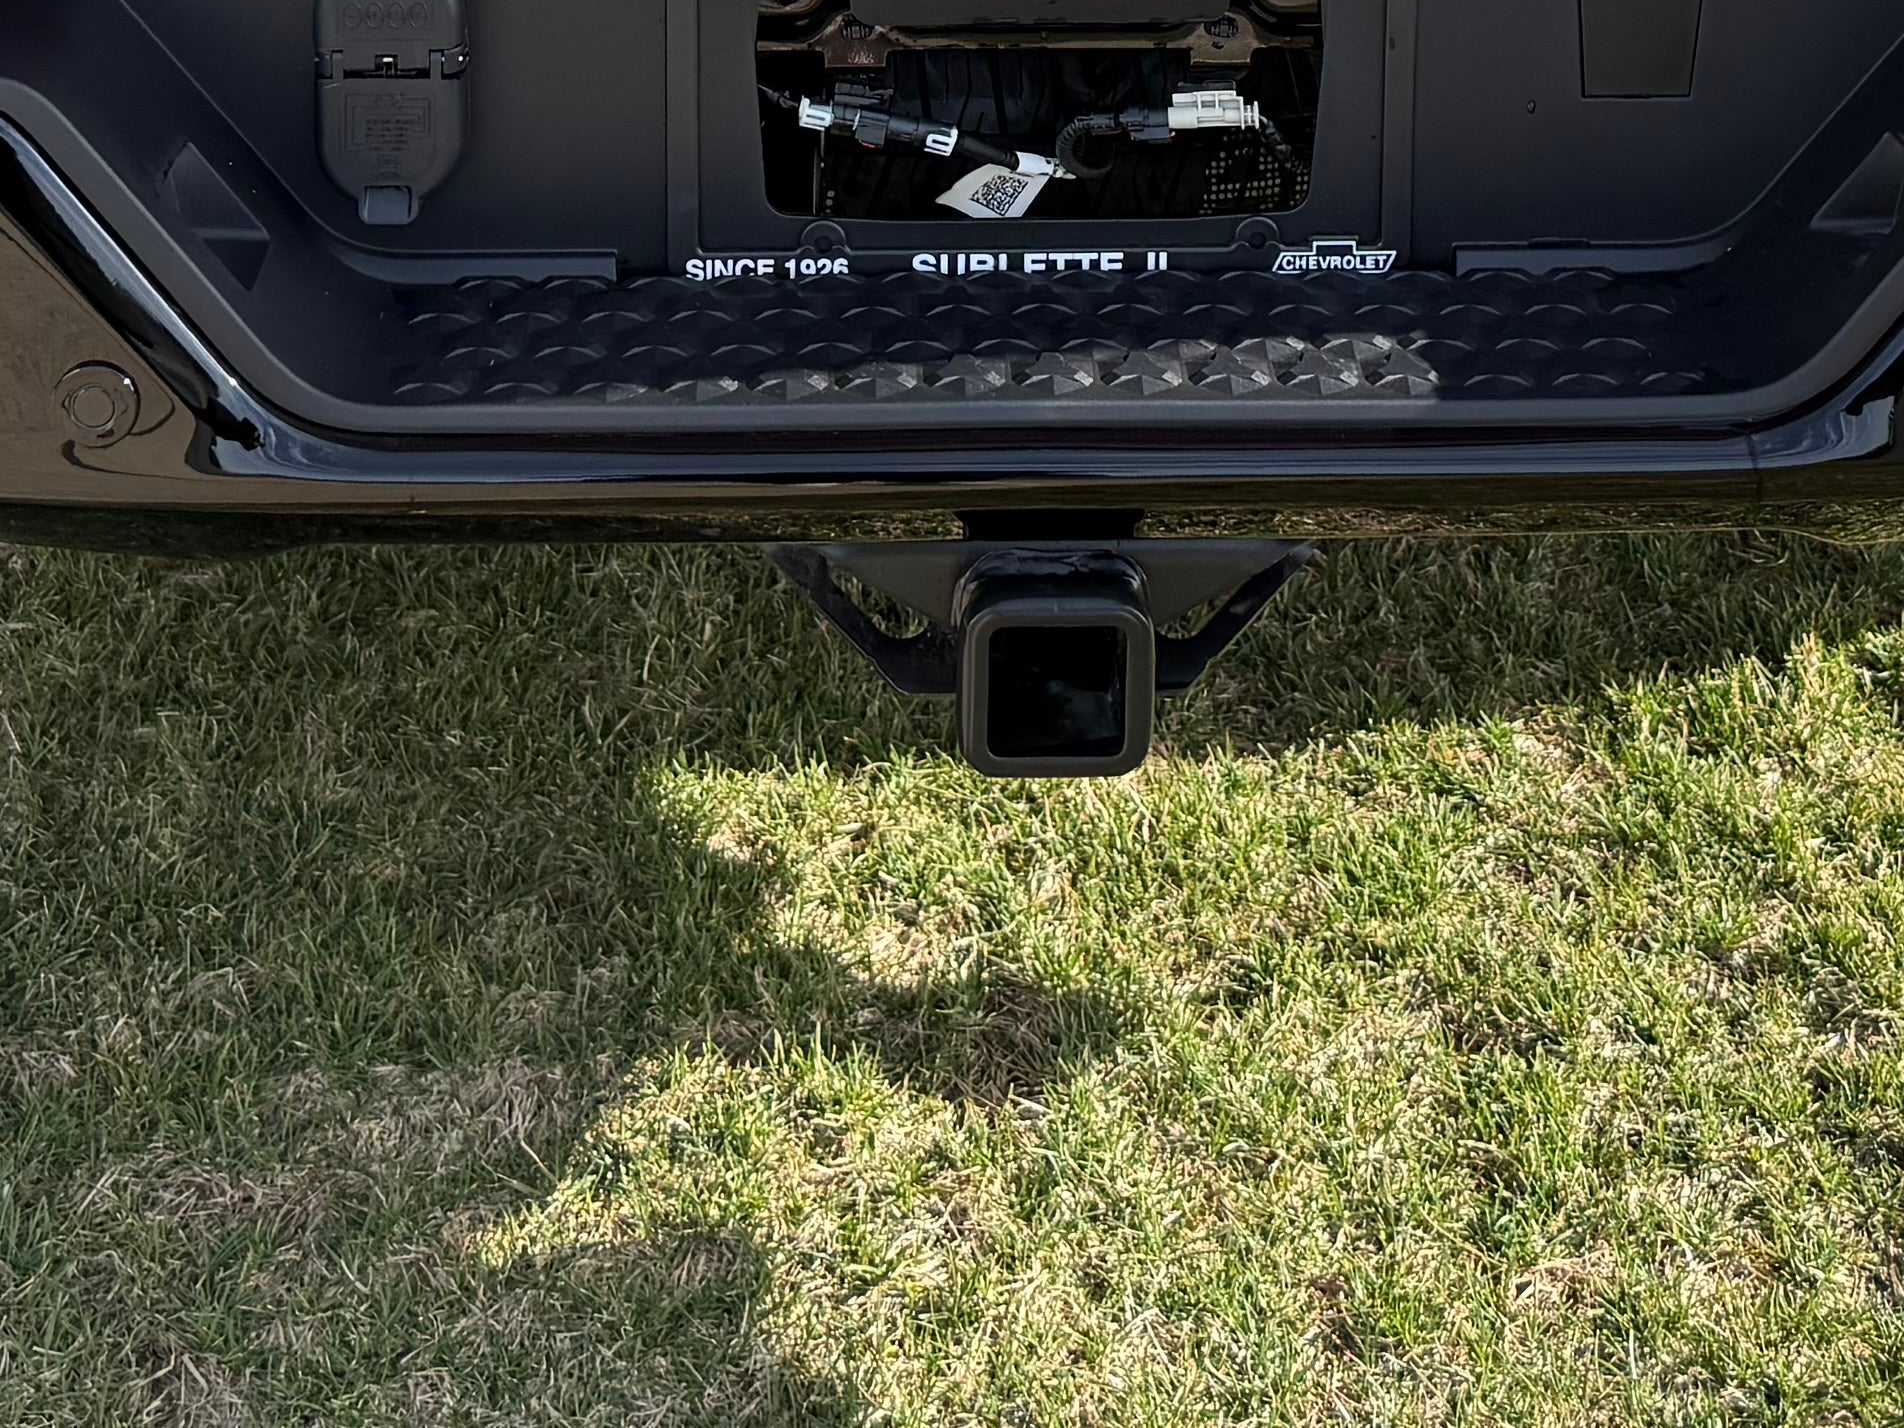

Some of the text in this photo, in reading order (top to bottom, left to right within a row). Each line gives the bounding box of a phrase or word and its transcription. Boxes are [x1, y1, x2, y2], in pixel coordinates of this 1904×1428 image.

[685, 257, 849, 281] SINCE 1926
[1281, 254, 1388, 271] CHEVROLET
